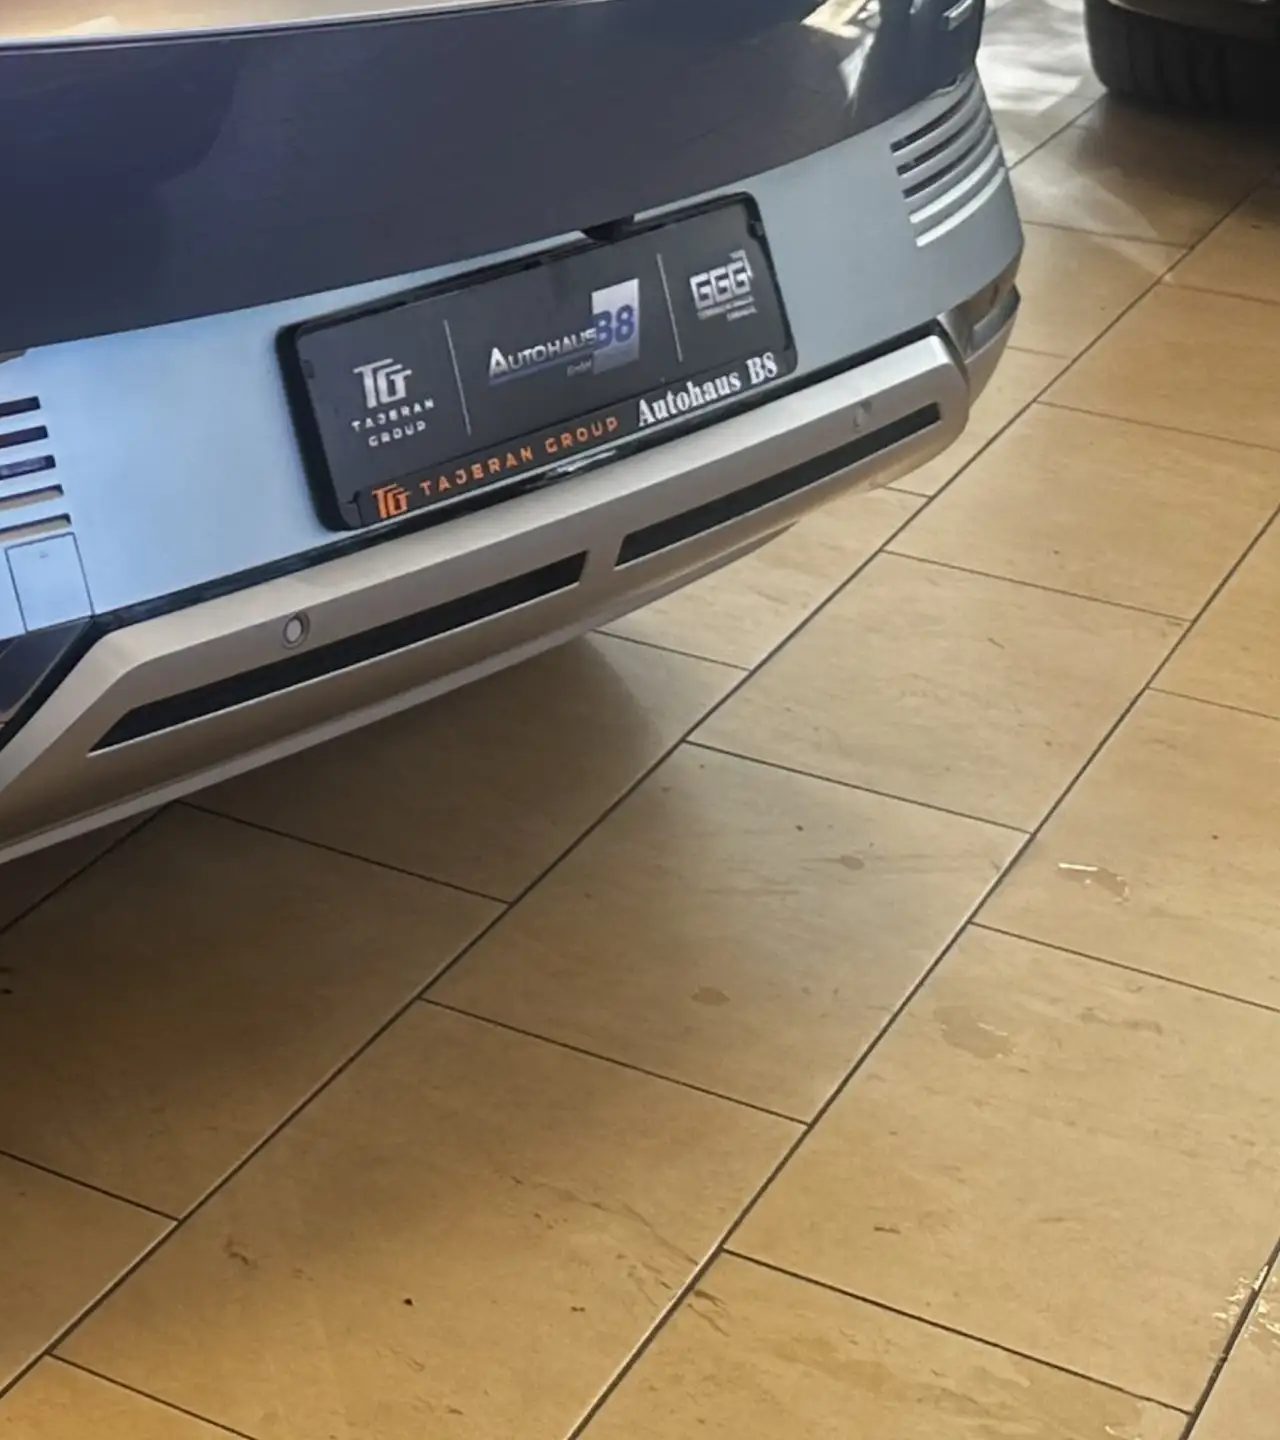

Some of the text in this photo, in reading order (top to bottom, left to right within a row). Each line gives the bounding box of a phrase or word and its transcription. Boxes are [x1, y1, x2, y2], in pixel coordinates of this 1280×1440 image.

[351, 398, 434, 432] TAJERAN
[637, 352, 779, 427] Autohaus B8
[368, 420, 426, 447] GROUP
[420, 446, 534, 497] TAJERAN
[545, 416, 619, 454] GROUP
